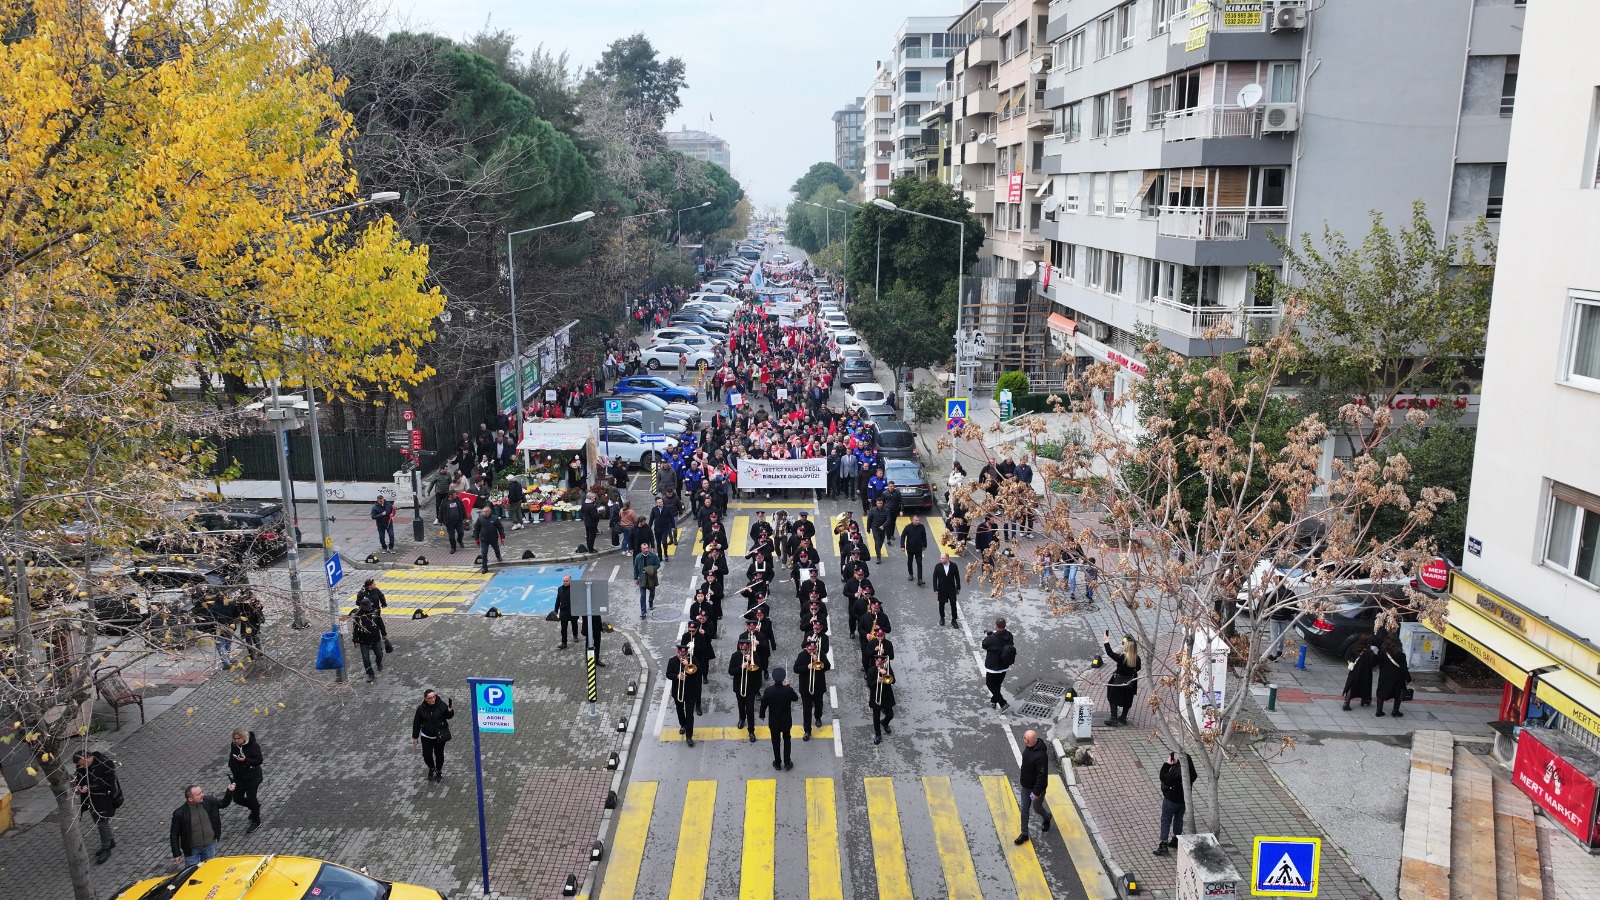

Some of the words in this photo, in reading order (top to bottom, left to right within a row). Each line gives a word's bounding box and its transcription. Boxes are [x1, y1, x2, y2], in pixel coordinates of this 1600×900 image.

[611, 402, 618, 410] P
[327, 561, 336, 585] P
[1423, 572, 1447, 580] MARKE
[1428, 567, 1447, 575] MERT
[489, 688, 502, 704] P
[1572, 708, 1592, 726] MERT
[1592, 720, 1600, 734] TE
[1520, 771, 1544, 796] MERT
[1544, 792, 1583, 827] MARKET
